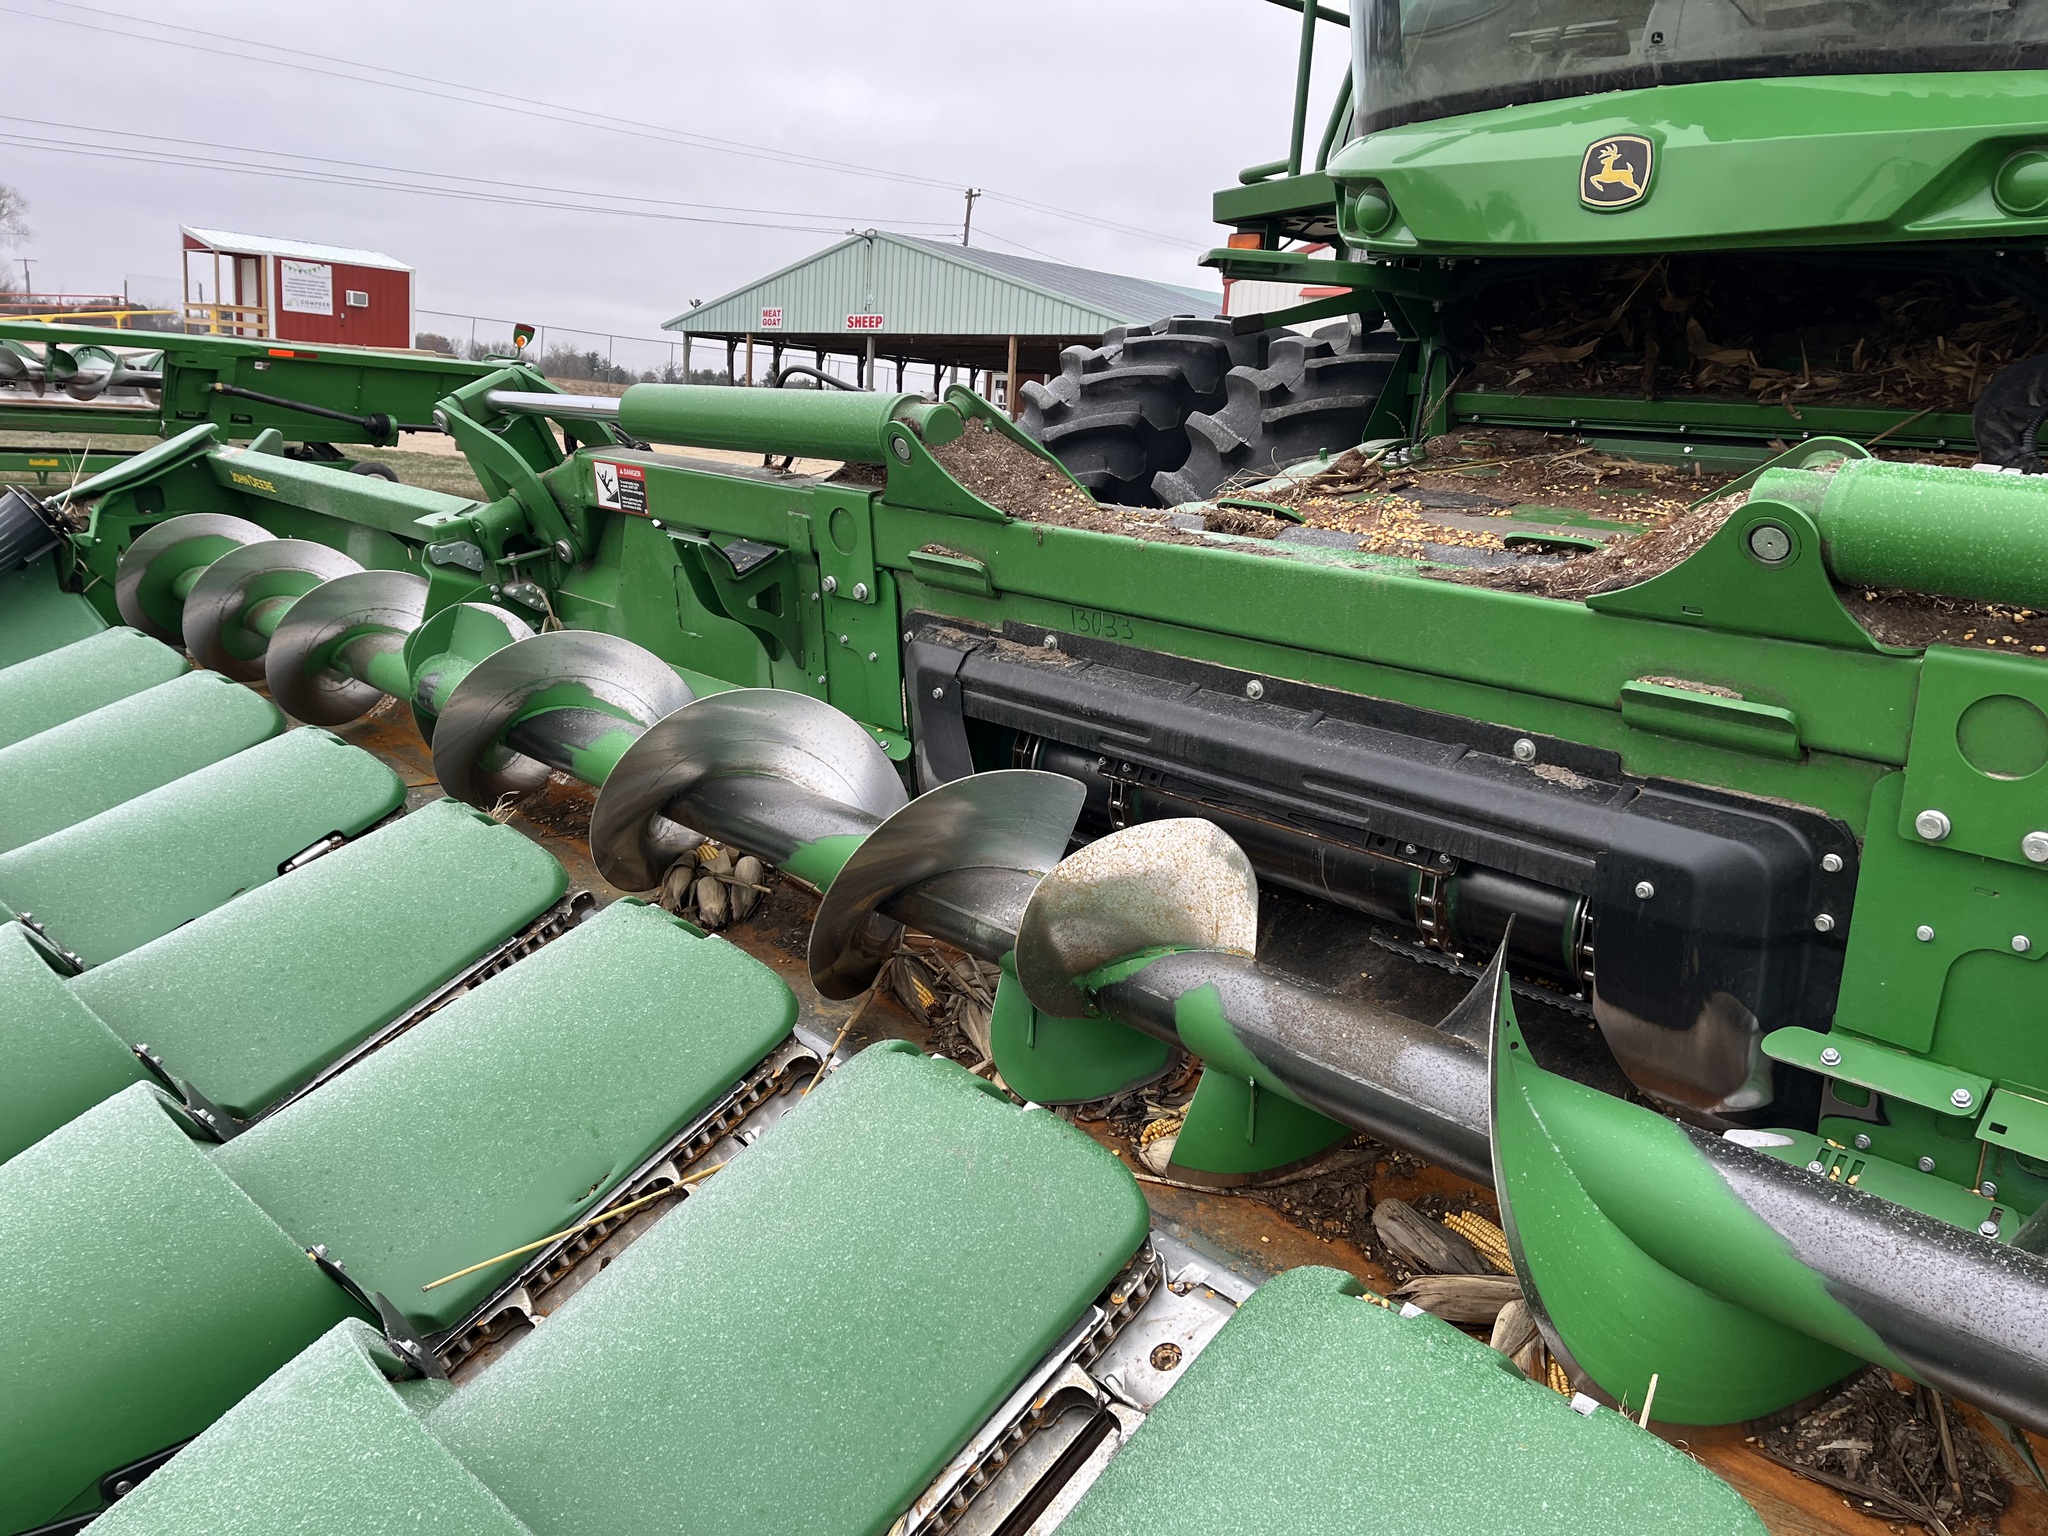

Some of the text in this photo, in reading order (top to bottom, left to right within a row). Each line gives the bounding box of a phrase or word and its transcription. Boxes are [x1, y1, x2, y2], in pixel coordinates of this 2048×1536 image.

[300, 299, 330, 307] COMPEER
[762, 309, 781, 318] MEAT
[762, 318, 781, 327] GOAT
[847, 315, 883, 329] SHEEP
[623, 468, 642, 478] DANGER
[229, 469, 277, 493] JOHN DEERE
[1071, 606, 1134, 640] 13033
